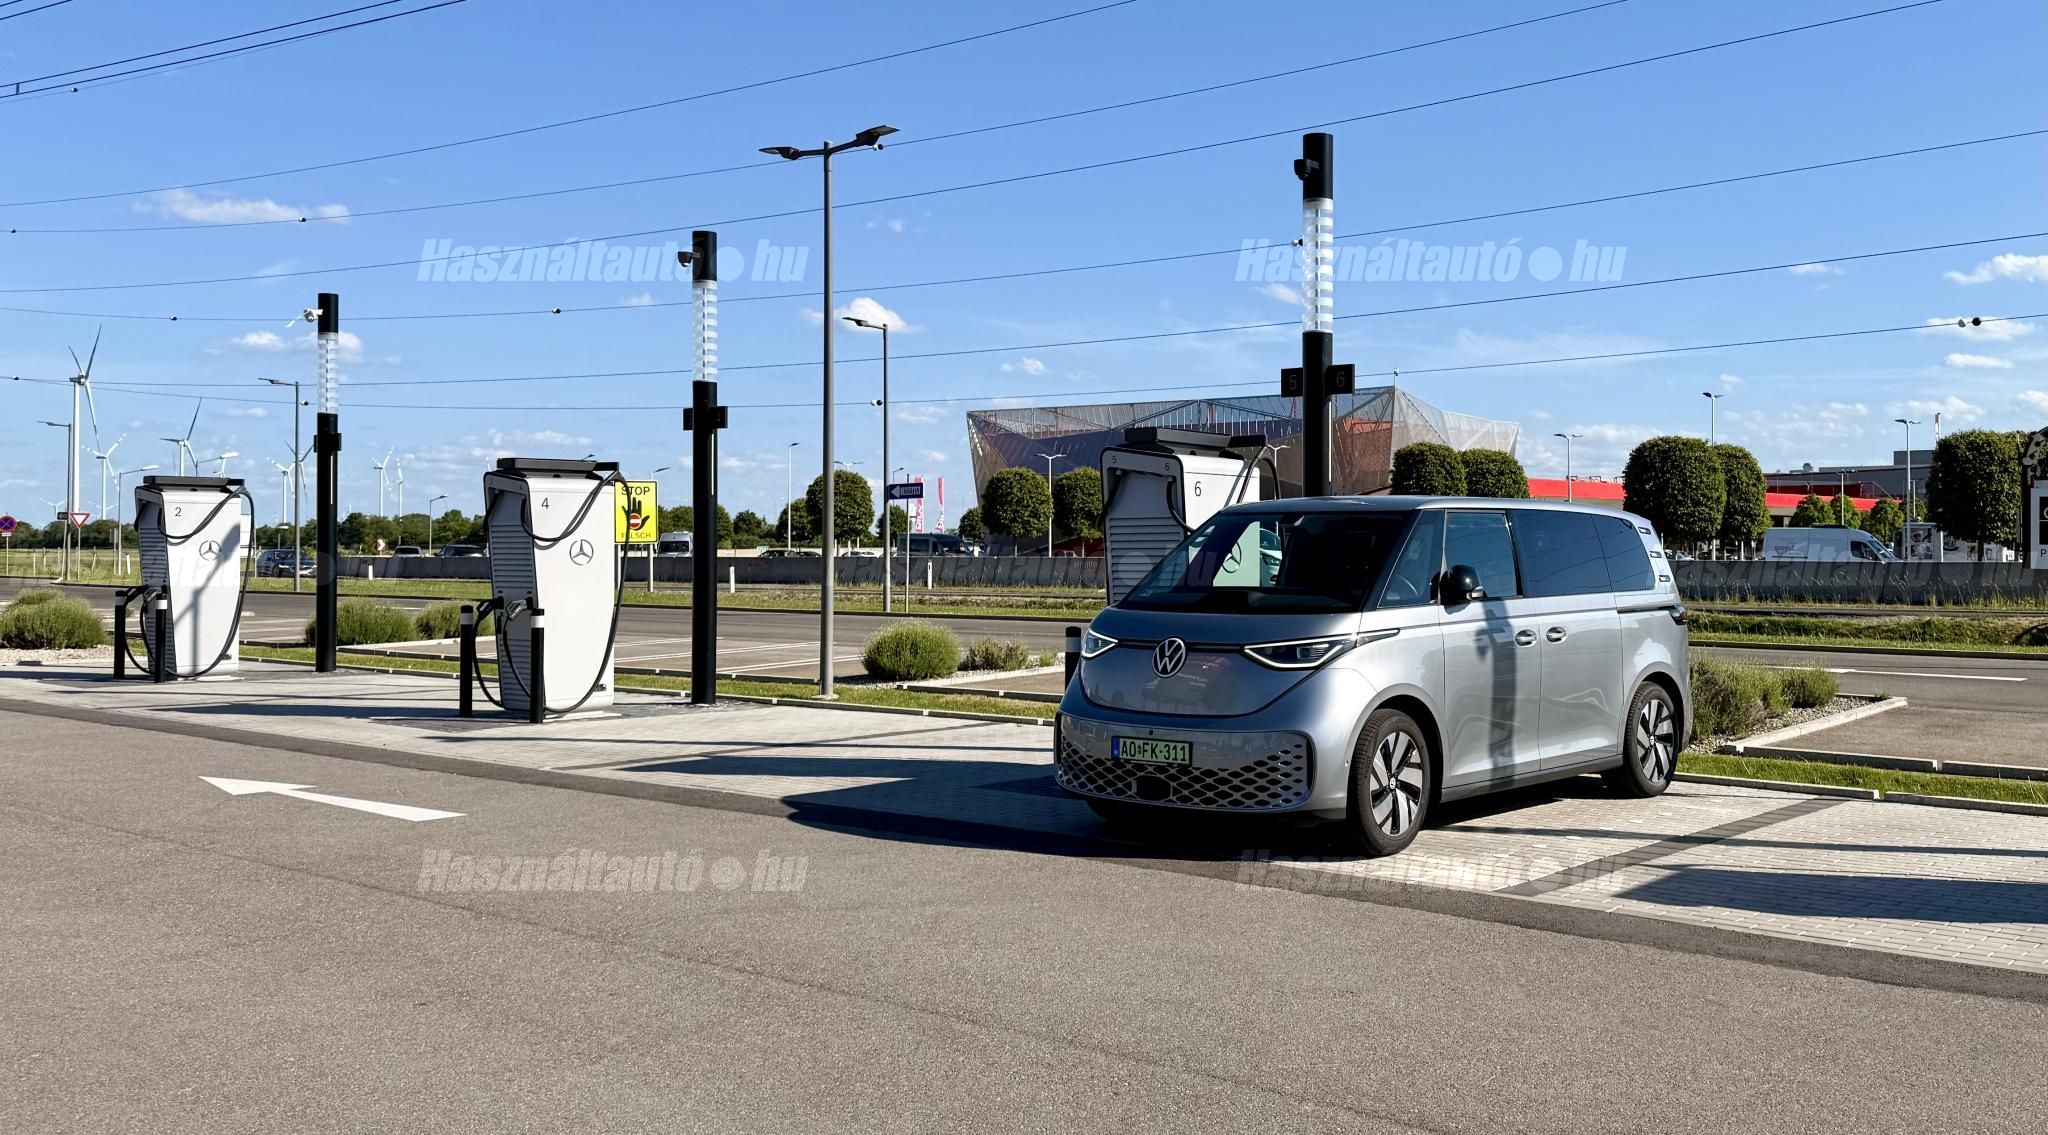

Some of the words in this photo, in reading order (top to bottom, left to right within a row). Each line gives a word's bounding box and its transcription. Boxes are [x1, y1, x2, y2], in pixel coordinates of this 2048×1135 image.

[621, 486, 650, 496] STOP
[1194, 480, 1202, 497] 6
[541, 497, 550, 510] 4
[174, 506, 182, 517] 2
